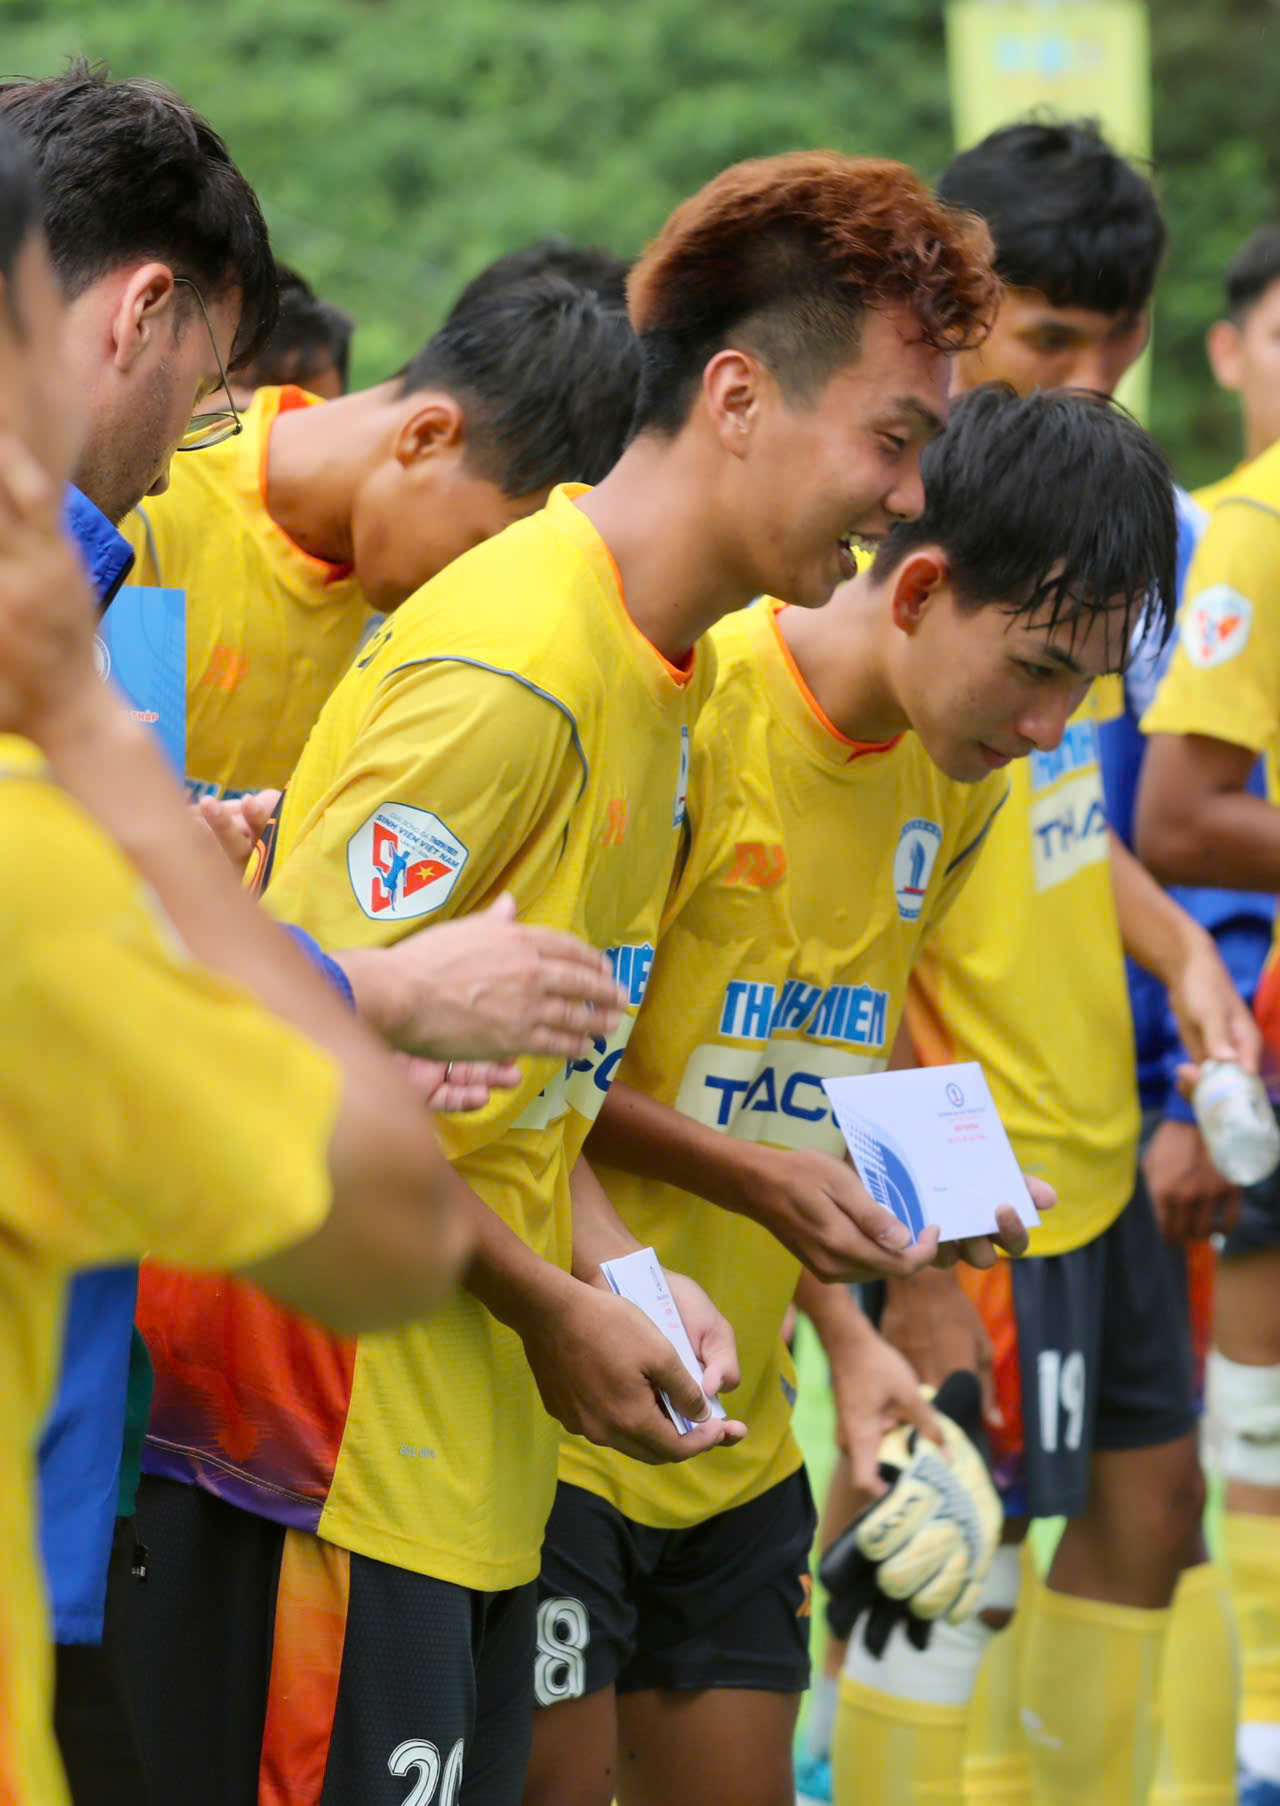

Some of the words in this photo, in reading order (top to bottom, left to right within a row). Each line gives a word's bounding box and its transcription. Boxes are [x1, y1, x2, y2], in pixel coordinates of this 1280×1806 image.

[705, 1065, 841, 1130] TAC
[1037, 1350, 1087, 1452] 19
[534, 1597, 591, 1707] 8
